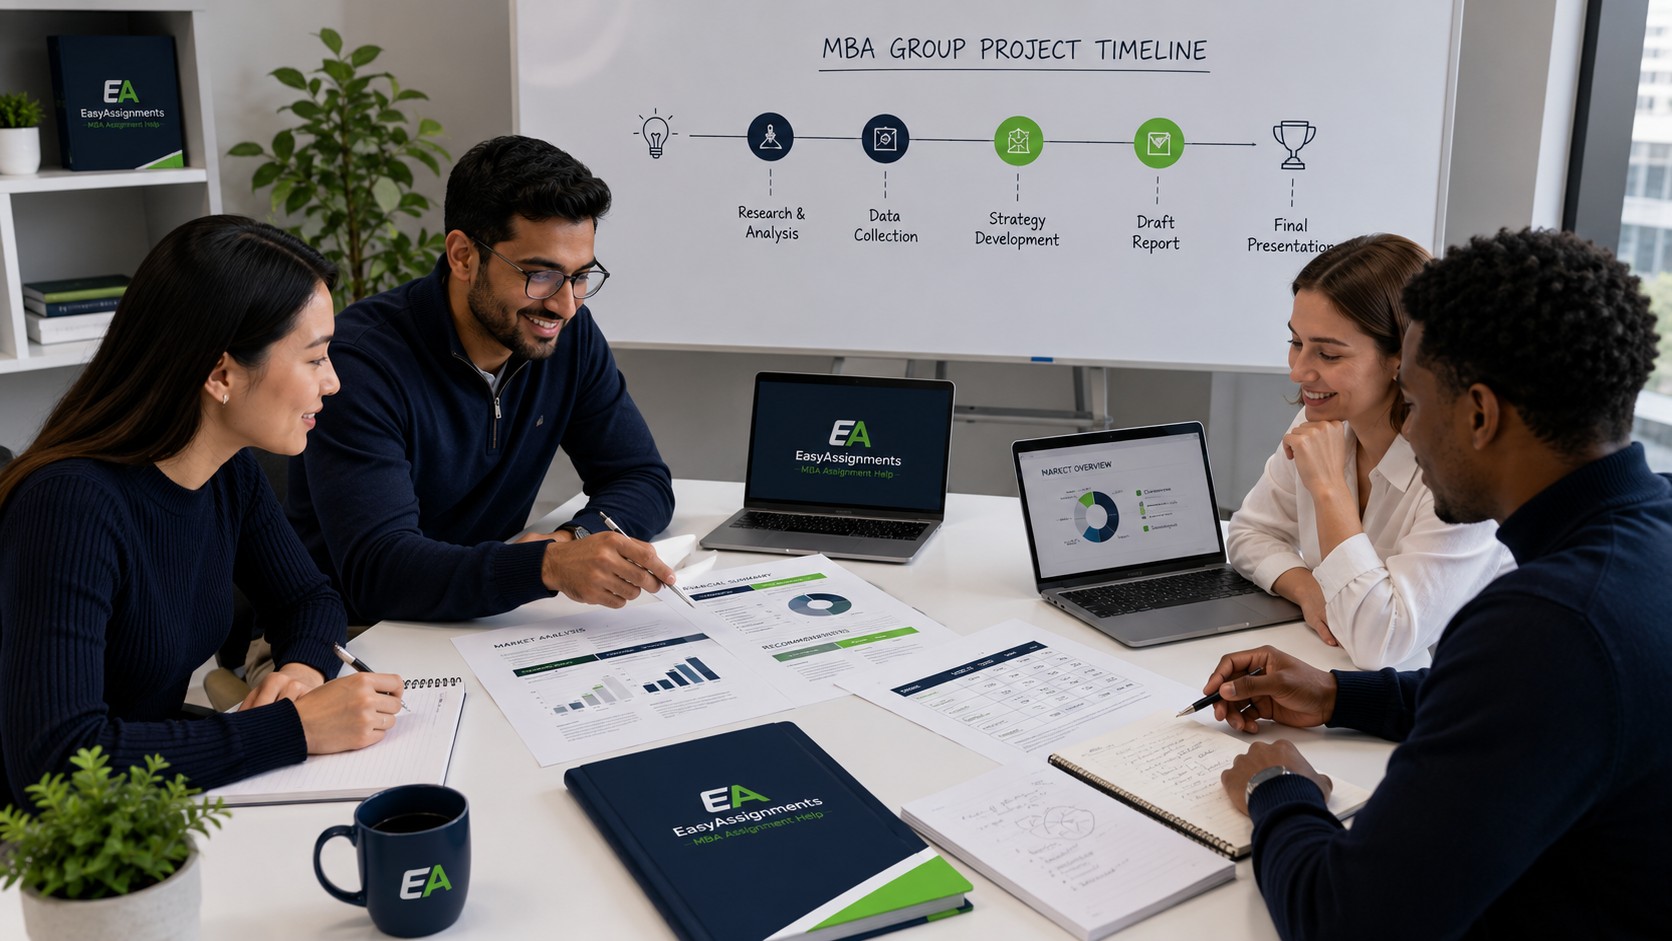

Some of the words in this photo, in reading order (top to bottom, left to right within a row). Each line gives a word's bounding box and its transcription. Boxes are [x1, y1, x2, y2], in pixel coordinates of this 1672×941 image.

[822, 37, 875, 60] MBA
[889, 37, 966, 60] GROUP
[980, 38, 1082, 60] PROJECT
[1095, 39, 1208, 61] TIMELINE
[103, 79, 140, 104] EA
[80, 108, 165, 120] EasyAssignments
[738, 205, 793, 220] Research
[796, 206, 806, 220] &
[869, 208, 901, 222] Data
[989, 211, 1046, 230] Strategy
[1136, 214, 1176, 230] Draft
[745, 224, 800, 244] Analysis
[853, 227, 919, 243] Collection
[1274, 217, 1308, 233] Final
[974, 231, 1060, 251] Development
[1132, 234, 1180, 254] Report
[829, 419, 871, 448] EA
[795, 450, 902, 466] EasyAssignments
[699, 784, 772, 814] EA
[672, 797, 824, 838] EasyAssignments
[692, 833, 724, 847] MBA
[725, 816, 795, 839] Assignment
[399, 864, 453, 900] EA
